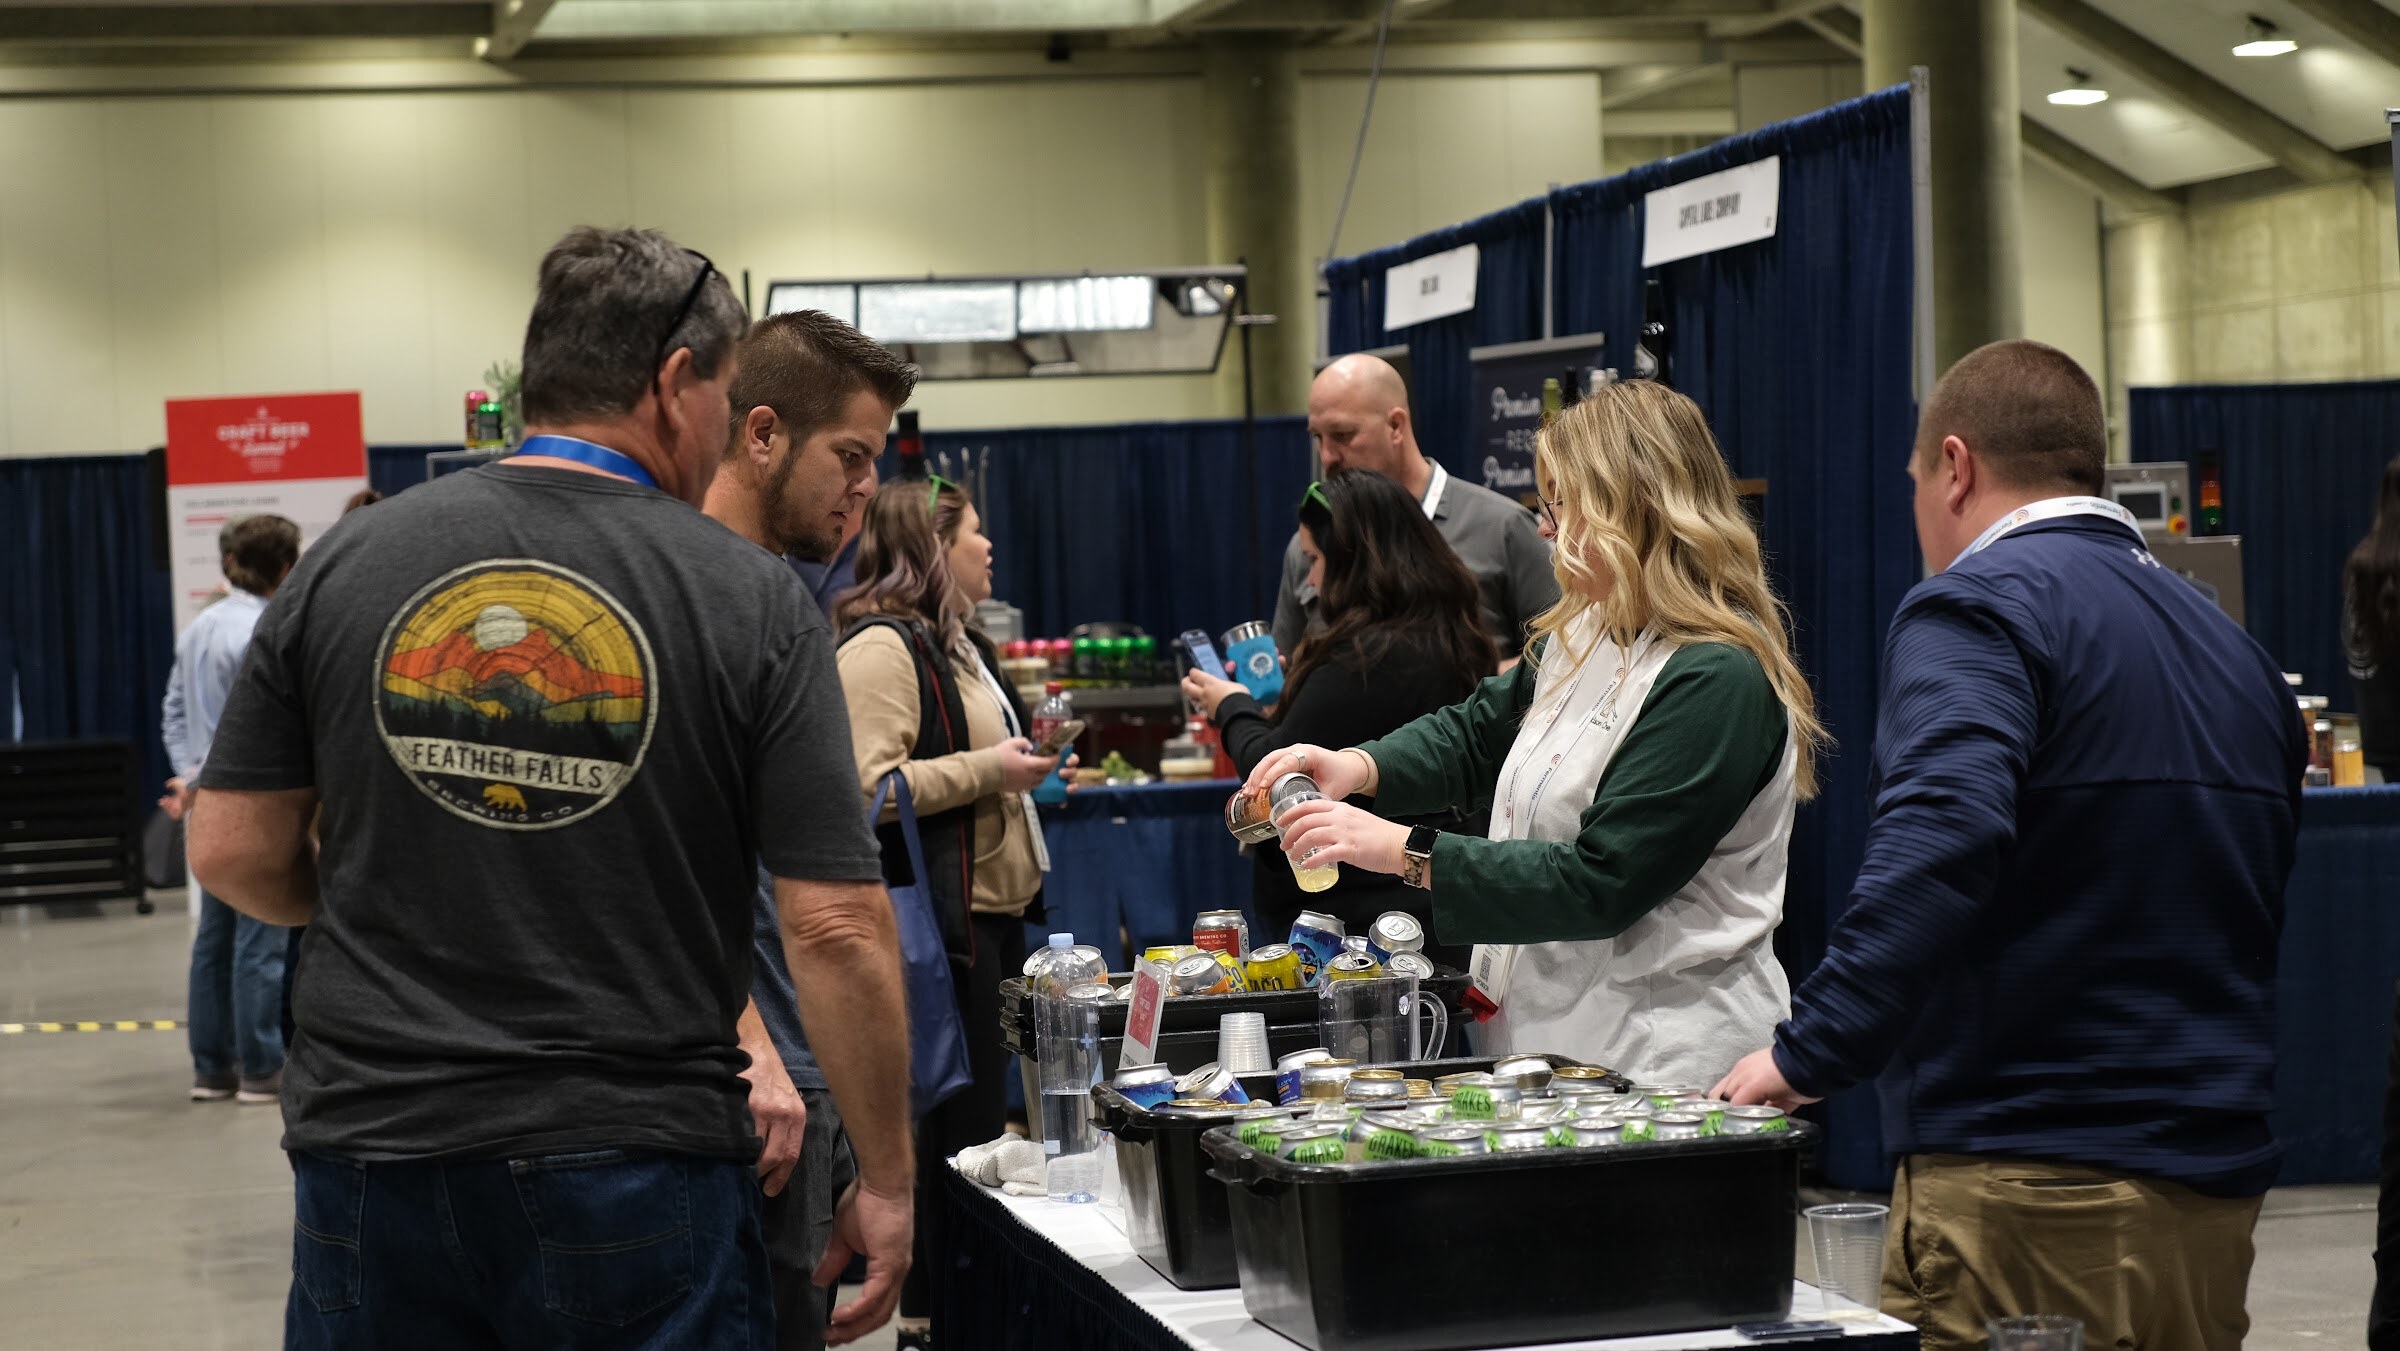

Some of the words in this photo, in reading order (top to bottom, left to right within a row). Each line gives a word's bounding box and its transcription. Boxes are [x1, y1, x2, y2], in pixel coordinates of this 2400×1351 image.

[411, 743, 516, 777] FEATHER
[526, 757, 603, 789] FALLS
[1532, 767, 1553, 800] Fermentis
[427, 779, 529, 822] BREWING
